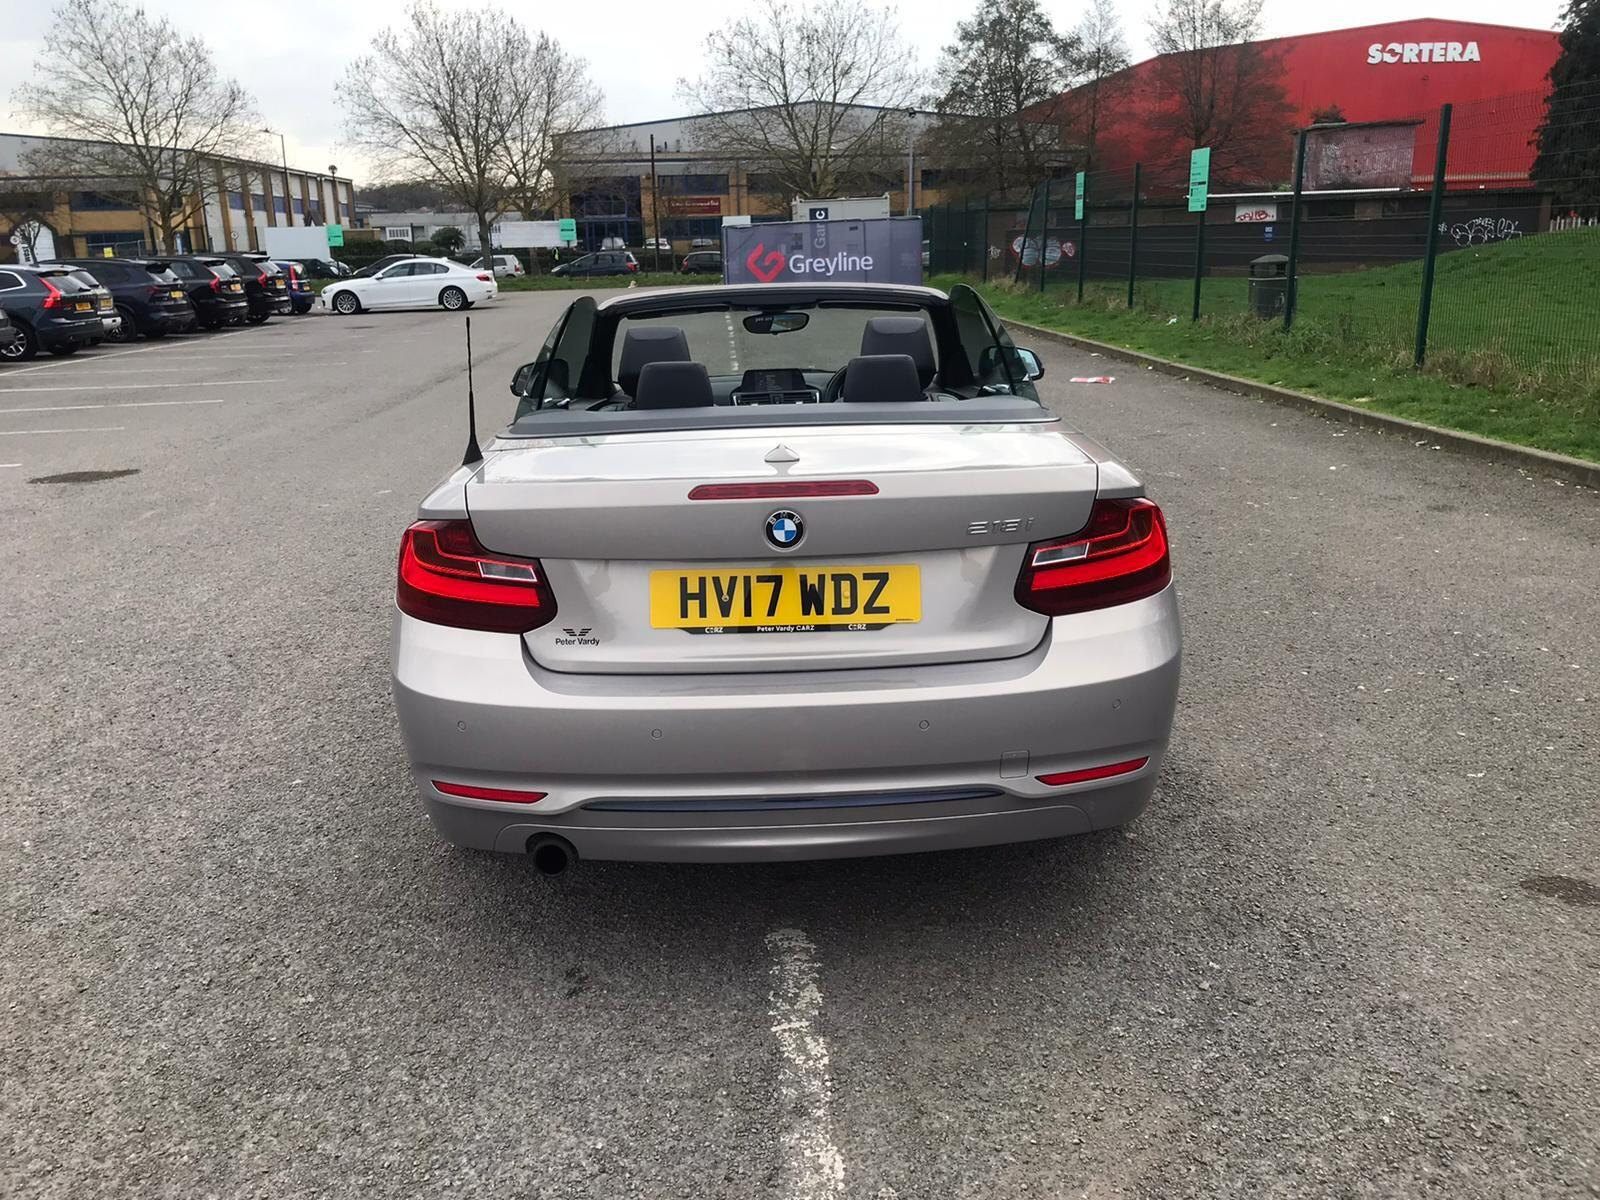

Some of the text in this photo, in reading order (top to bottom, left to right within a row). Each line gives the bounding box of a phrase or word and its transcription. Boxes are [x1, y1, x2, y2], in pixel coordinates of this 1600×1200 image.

[1367, 42, 1480, 64] SORTERA
[814, 210, 826, 249] Garc
[789, 252, 873, 276] Greyline
[680, 572, 890, 618] HV17 WDZ
[776, 625, 795, 633] Vardy
[577, 637, 600, 646] Vardy
